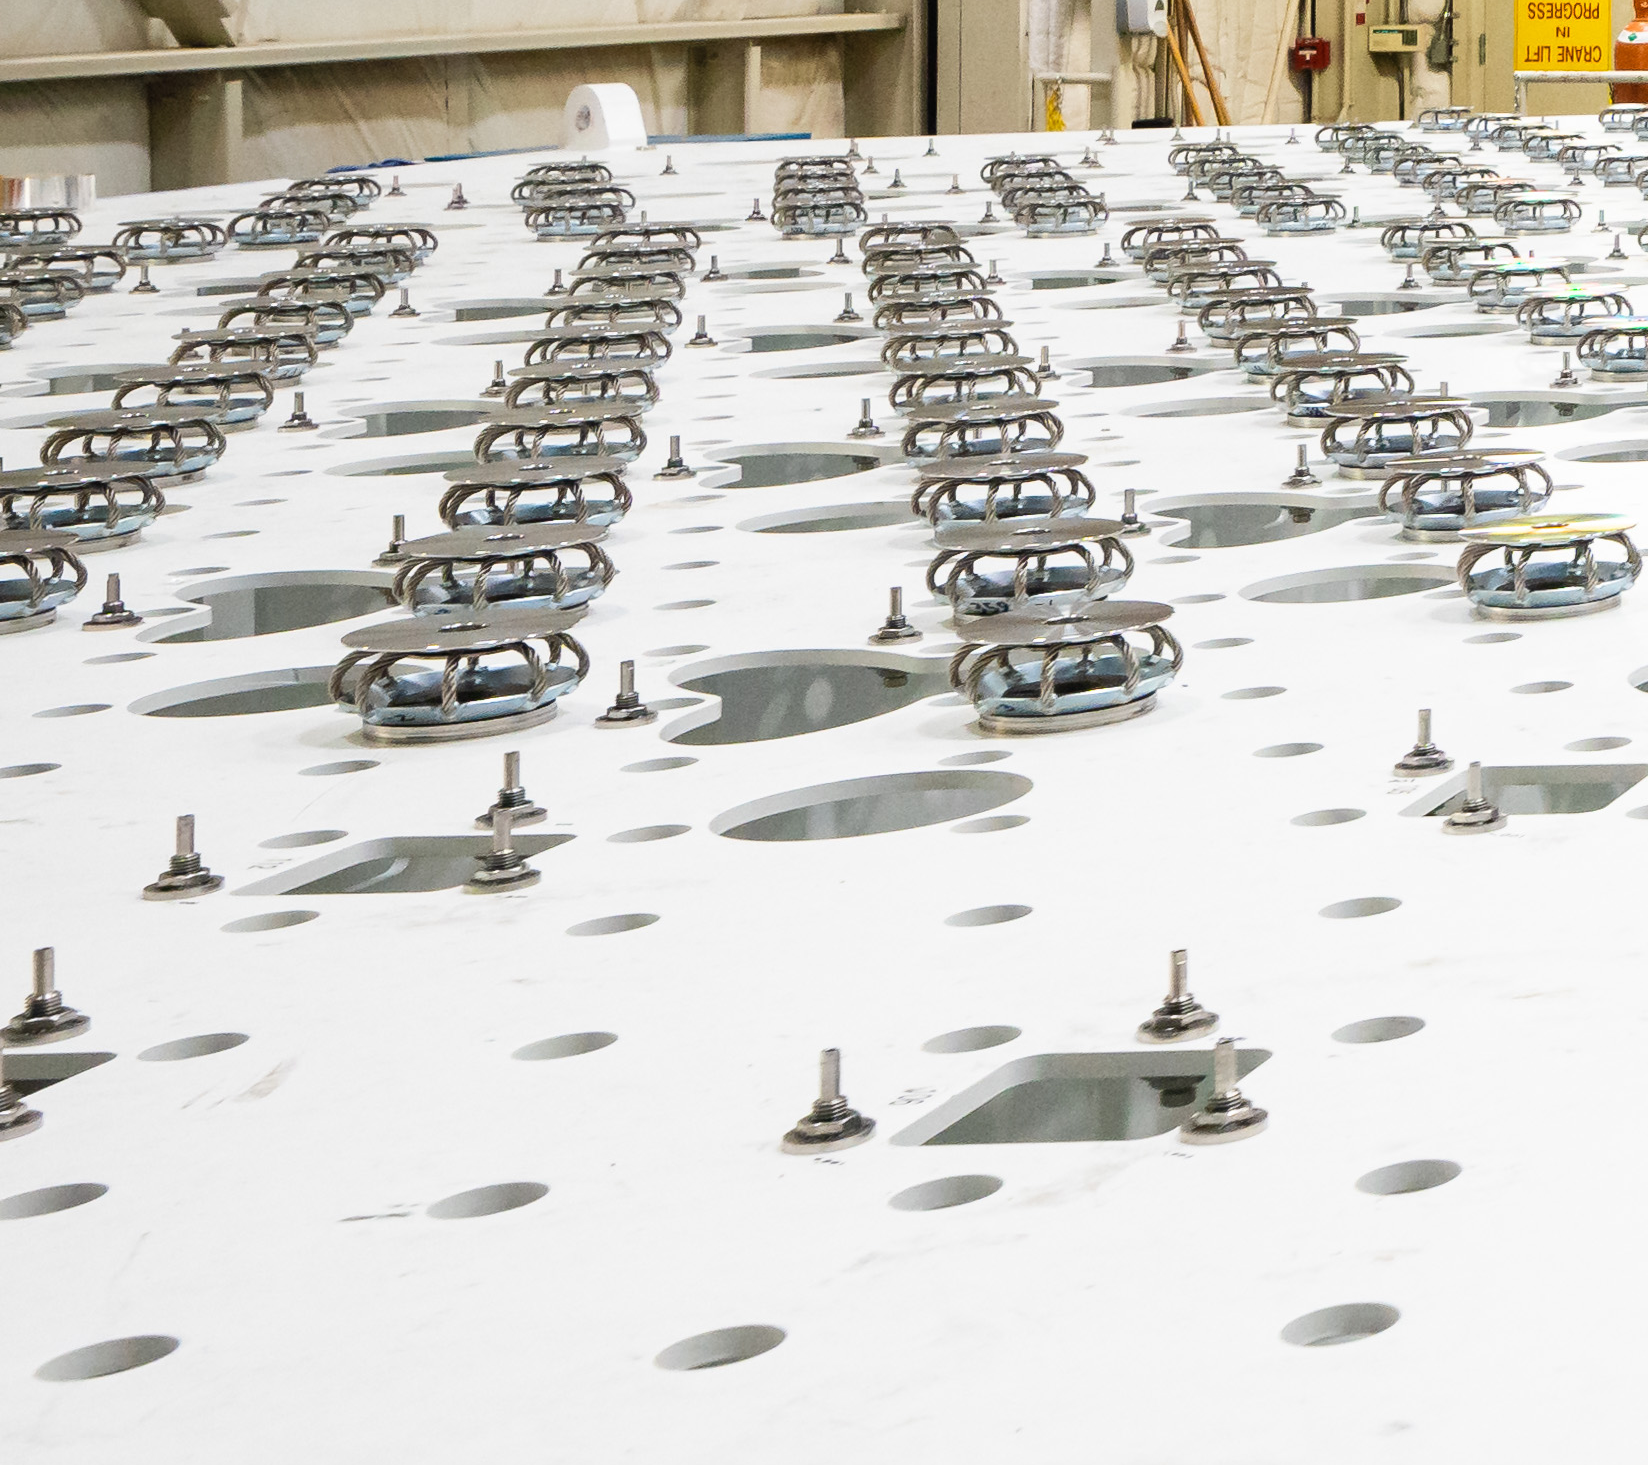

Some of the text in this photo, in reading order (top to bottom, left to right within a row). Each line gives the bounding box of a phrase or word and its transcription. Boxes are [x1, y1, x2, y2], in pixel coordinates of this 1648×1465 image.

[1527, 2, 1600, 19] PROGRESS
[1556, 26, 1570, 38] IN
[1524, 45, 1602, 63] CRANE LIFT
